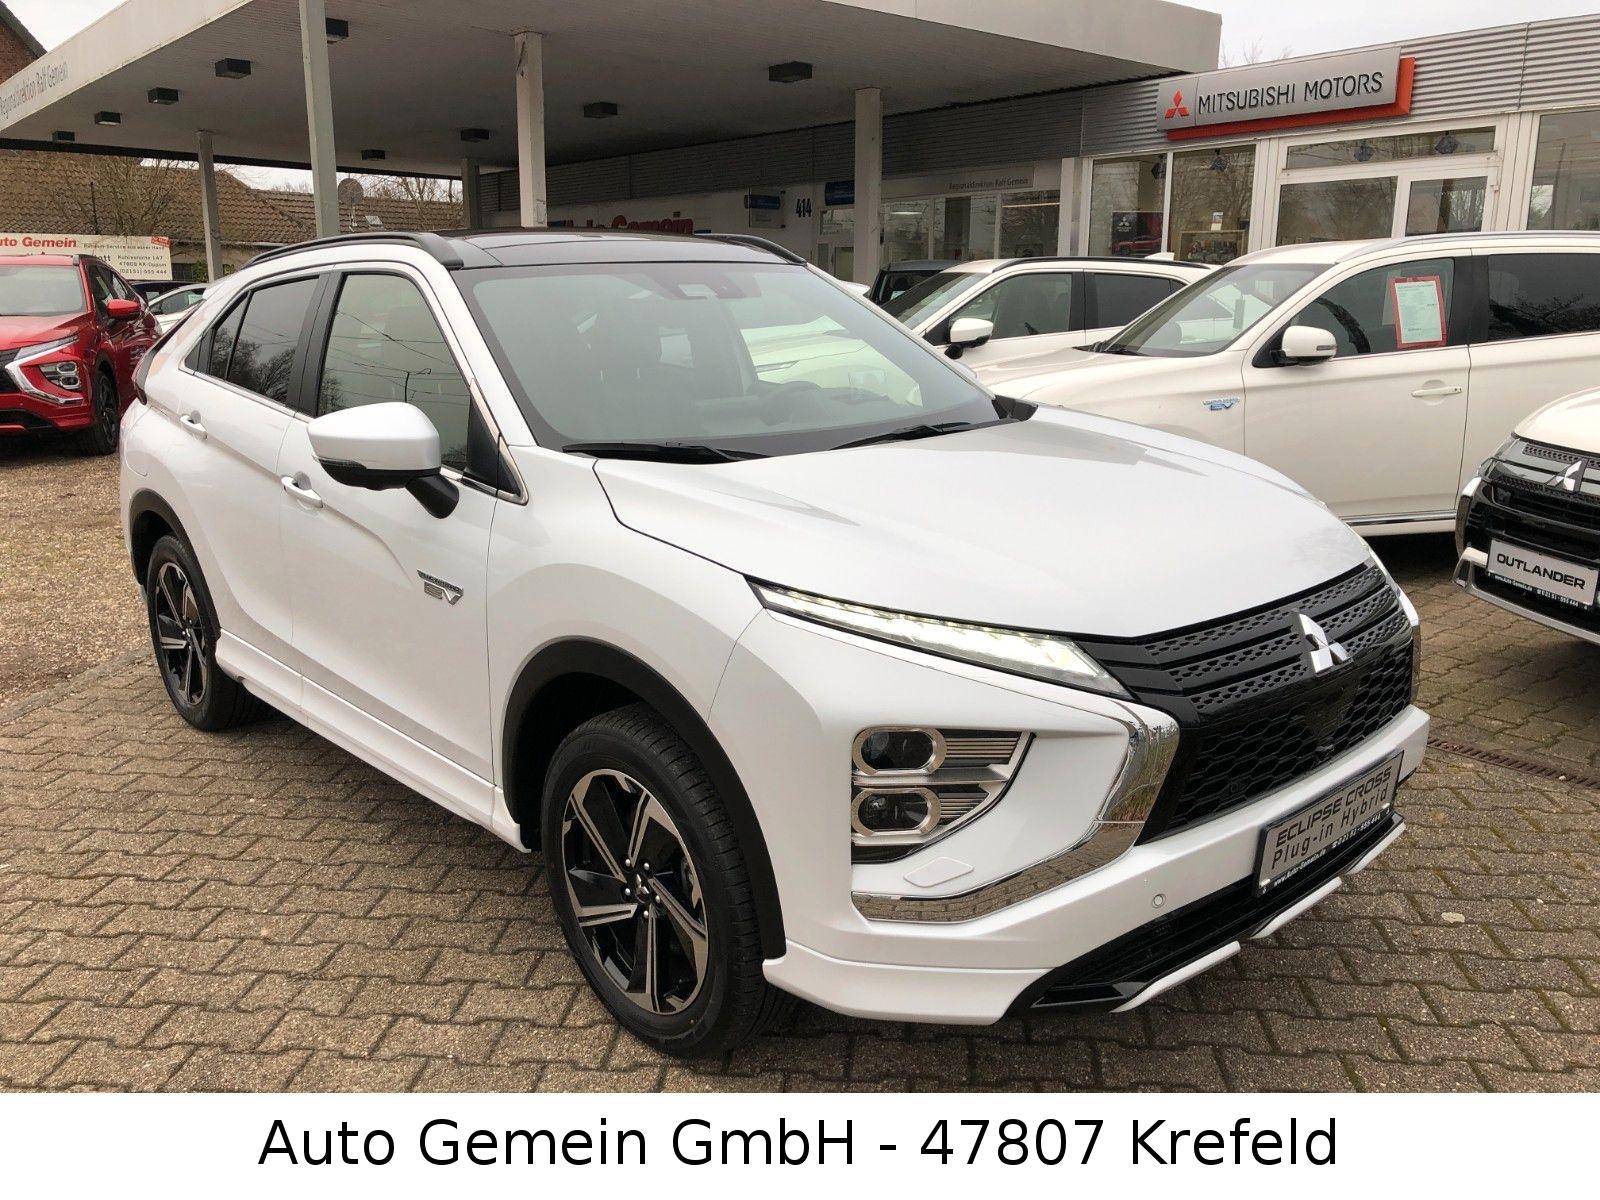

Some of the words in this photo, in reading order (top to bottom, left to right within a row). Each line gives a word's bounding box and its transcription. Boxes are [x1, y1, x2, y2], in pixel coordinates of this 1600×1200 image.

[1198, 83, 1296, 115] MITSUBISHI
[1304, 71, 1384, 102] MOTORS
[796, 198, 812, 217] 414
[22, 236, 77, 247] Gemein
[1497, 553, 1586, 590] OUTLANDER
[1271, 822, 1334, 870] Plug-in
[1340, 783, 1389, 828] Hybrid
[1276, 796, 1343, 848] ECLIPSE
[1345, 765, 1392, 807] CROSS
